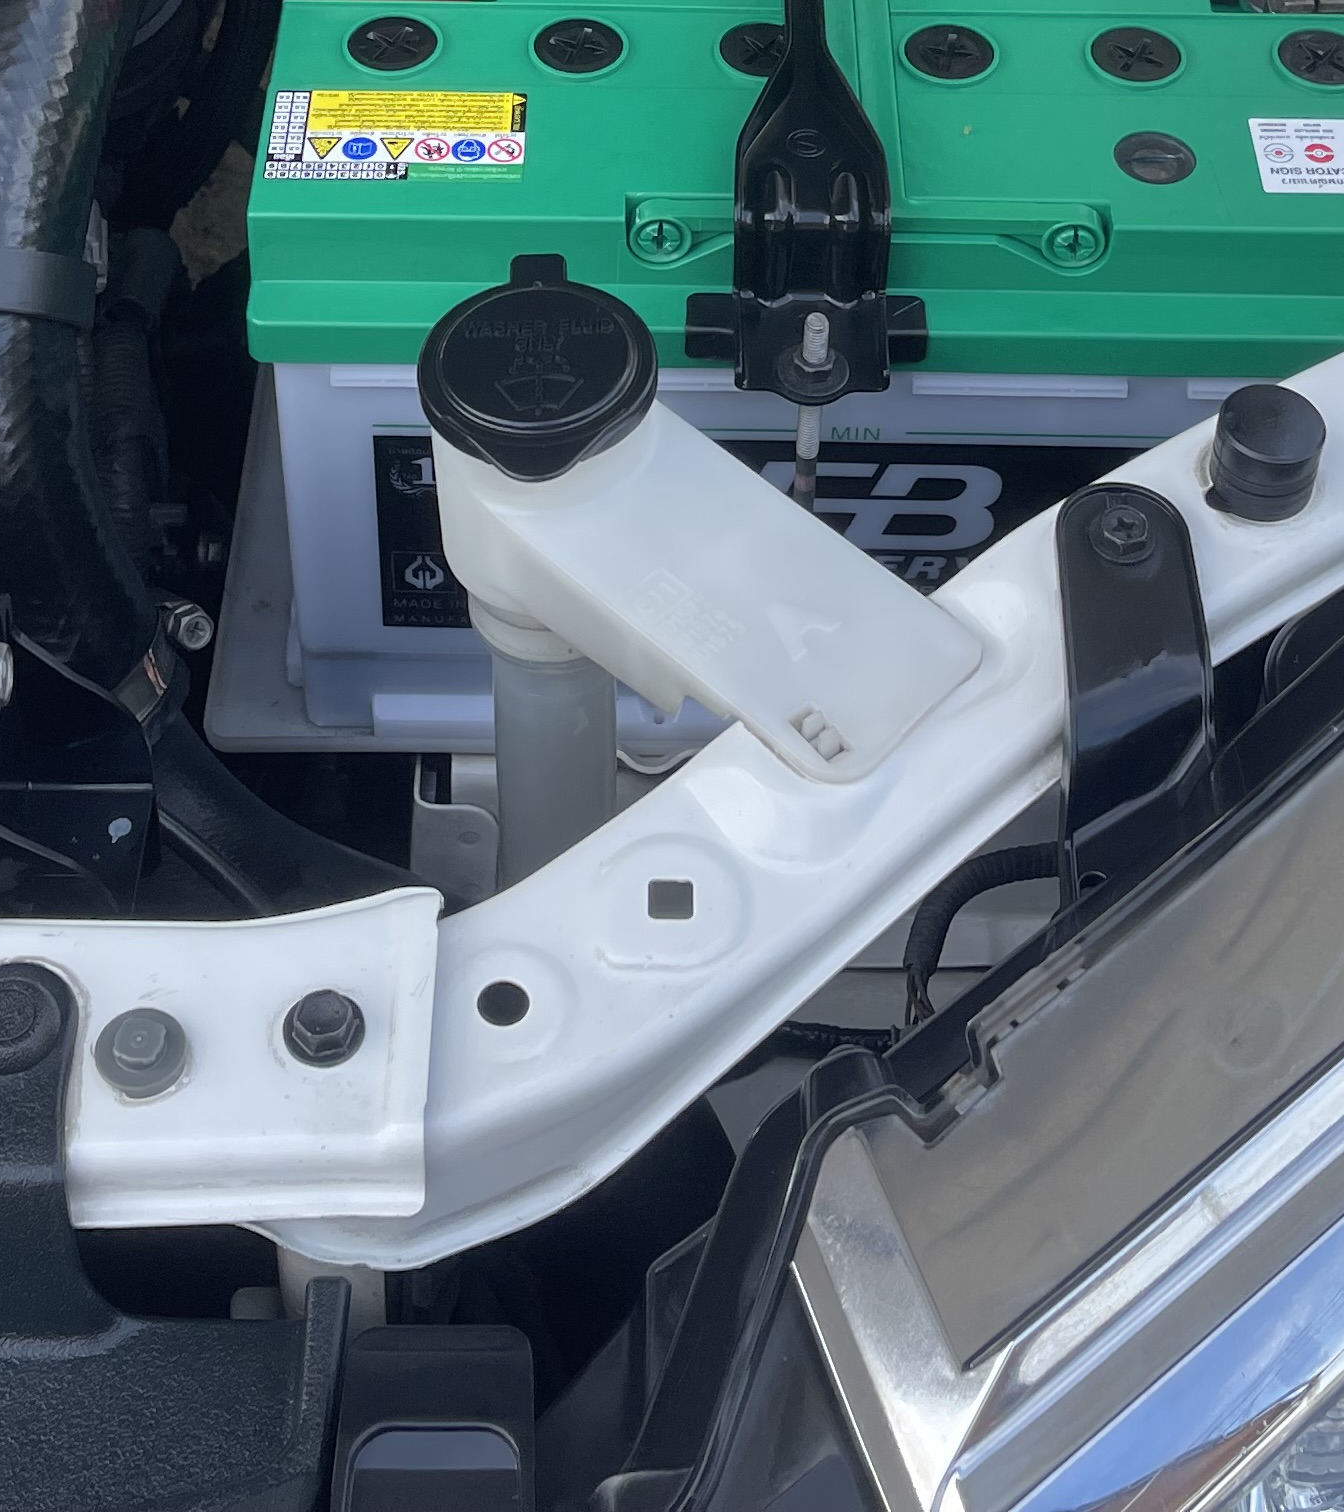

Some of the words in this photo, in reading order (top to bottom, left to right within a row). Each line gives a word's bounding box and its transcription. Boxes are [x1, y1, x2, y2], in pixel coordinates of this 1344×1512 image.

[1270, 167, 1303, 176] SIGN
[463, 319, 547, 340] WASHER
[558, 317, 616, 337] FLUID
[830, 425, 882, 442] MIN
[393, 598, 443, 610] MADE
